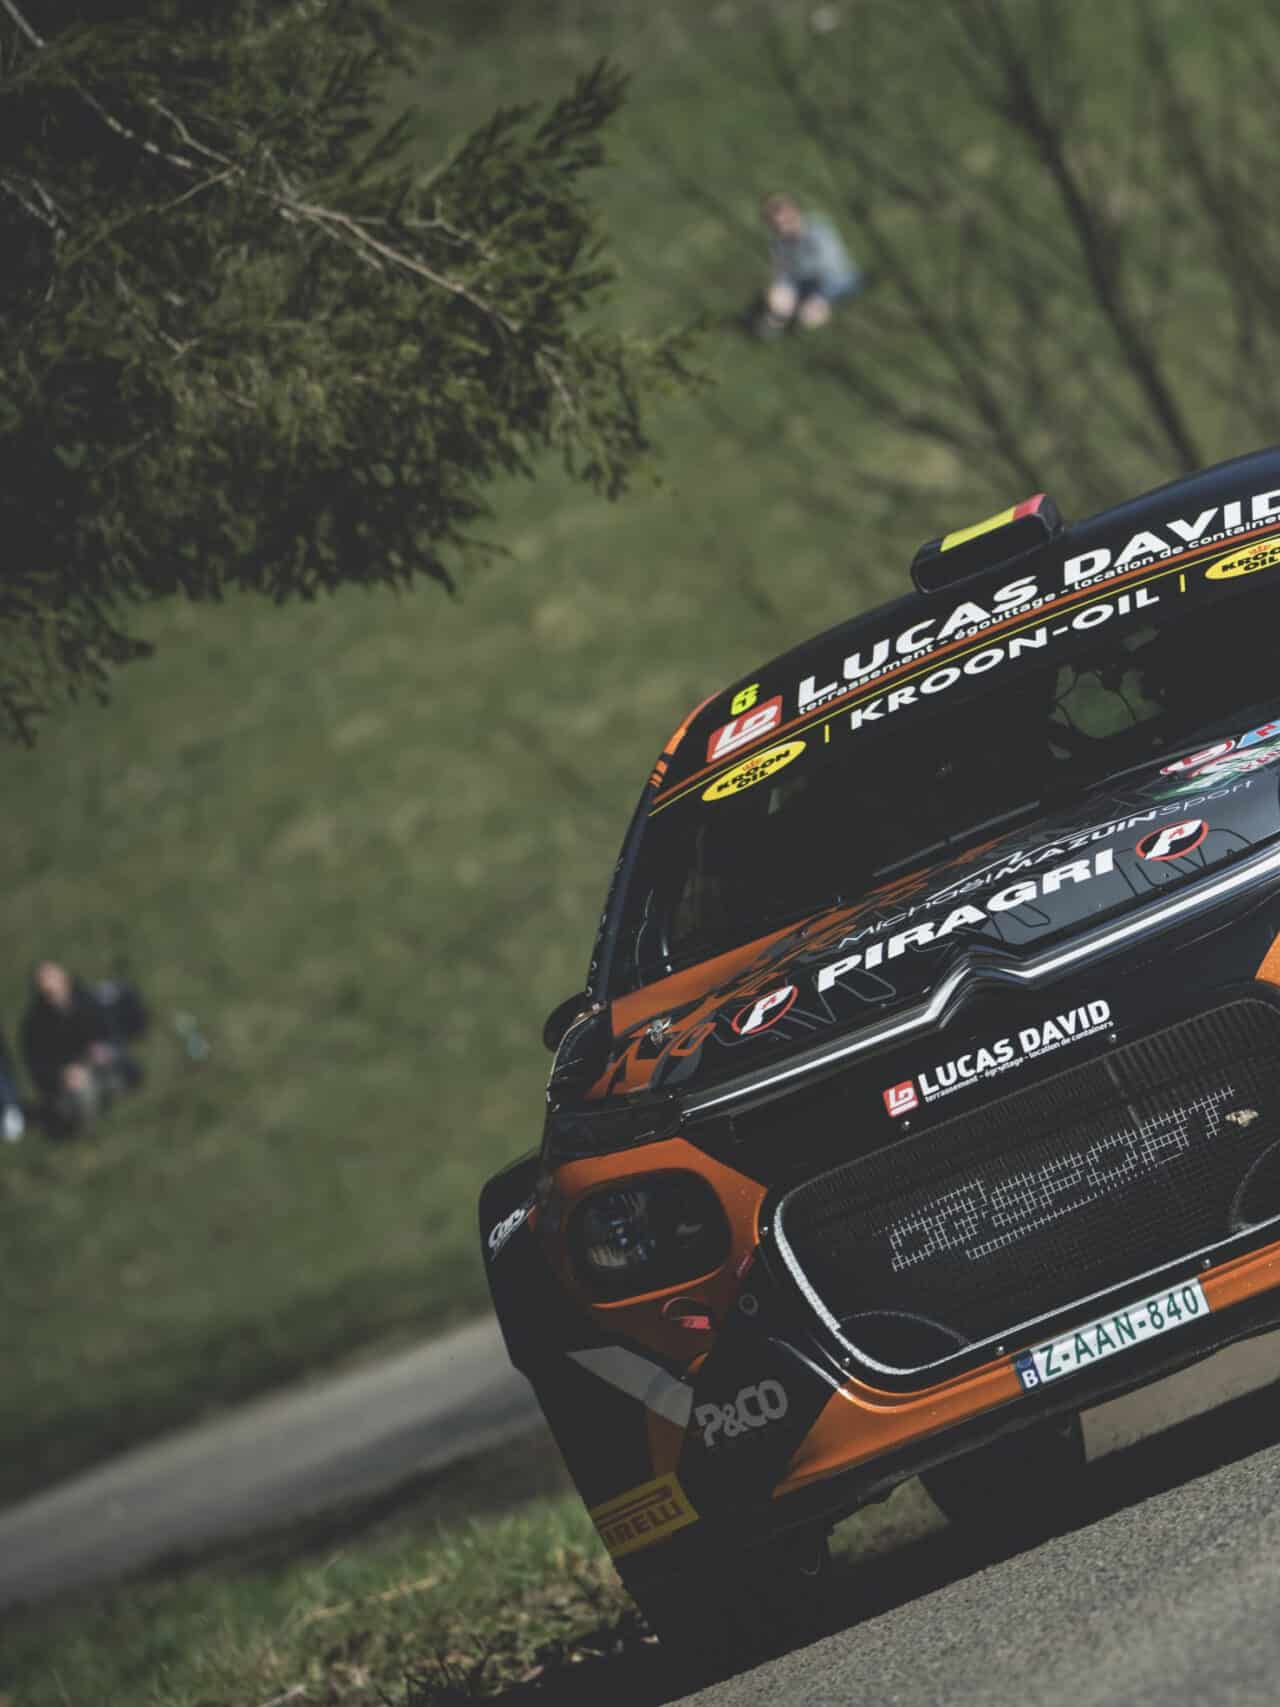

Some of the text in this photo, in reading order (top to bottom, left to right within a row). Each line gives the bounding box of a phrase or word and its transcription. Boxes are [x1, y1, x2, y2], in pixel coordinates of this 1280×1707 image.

[1244, 555, 1278, 572] OIL
[798, 576, 1038, 707] LUCAS
[799, 643, 936, 714] terrassement
[954, 592, 1056, 641] égouttage
[1073, 555, 1155, 591] location
[1160, 544, 1184, 559] de
[850, 588, 1160, 730] KROON-OIL
[716, 750, 791, 792] KROON
[736, 770, 768, 789] OIL
[817, 848, 1114, 993] PIRAGRI
[918, 1000, 1111, 1095] LUCAS DAVID
[1039, 1286, 1199, 1377] Z-AAN-840
[695, 1379, 789, 1448] P&CO
[1022, 1369, 1039, 1388] B
